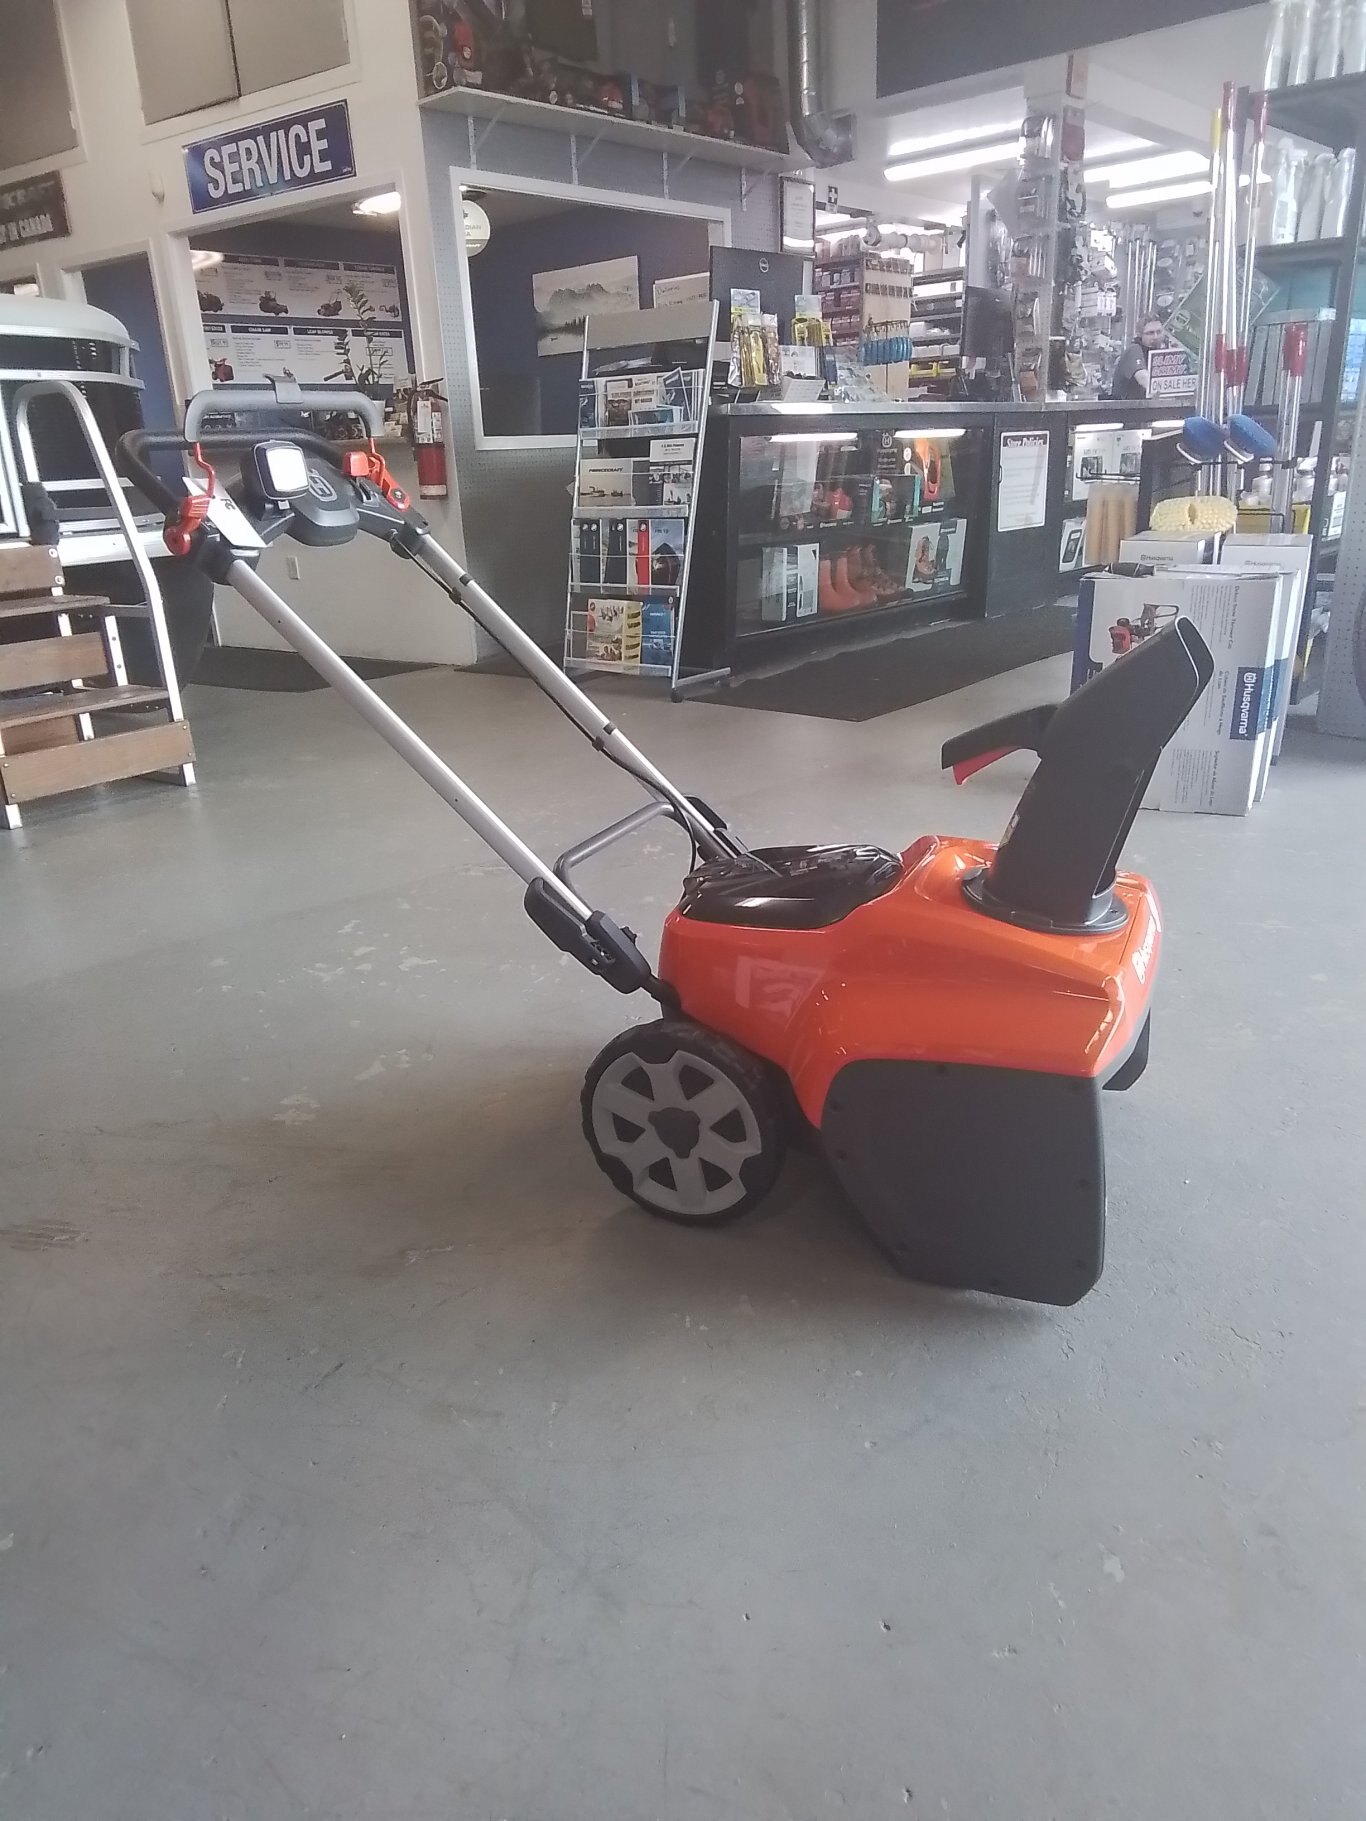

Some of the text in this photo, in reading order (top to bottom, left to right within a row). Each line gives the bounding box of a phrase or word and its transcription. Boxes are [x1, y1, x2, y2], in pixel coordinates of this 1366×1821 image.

[204, 118, 332, 199] SERVICE
[1153, 377, 1197, 391] ON SALE HER
[1239, 683, 1255, 735] Husqvarna
